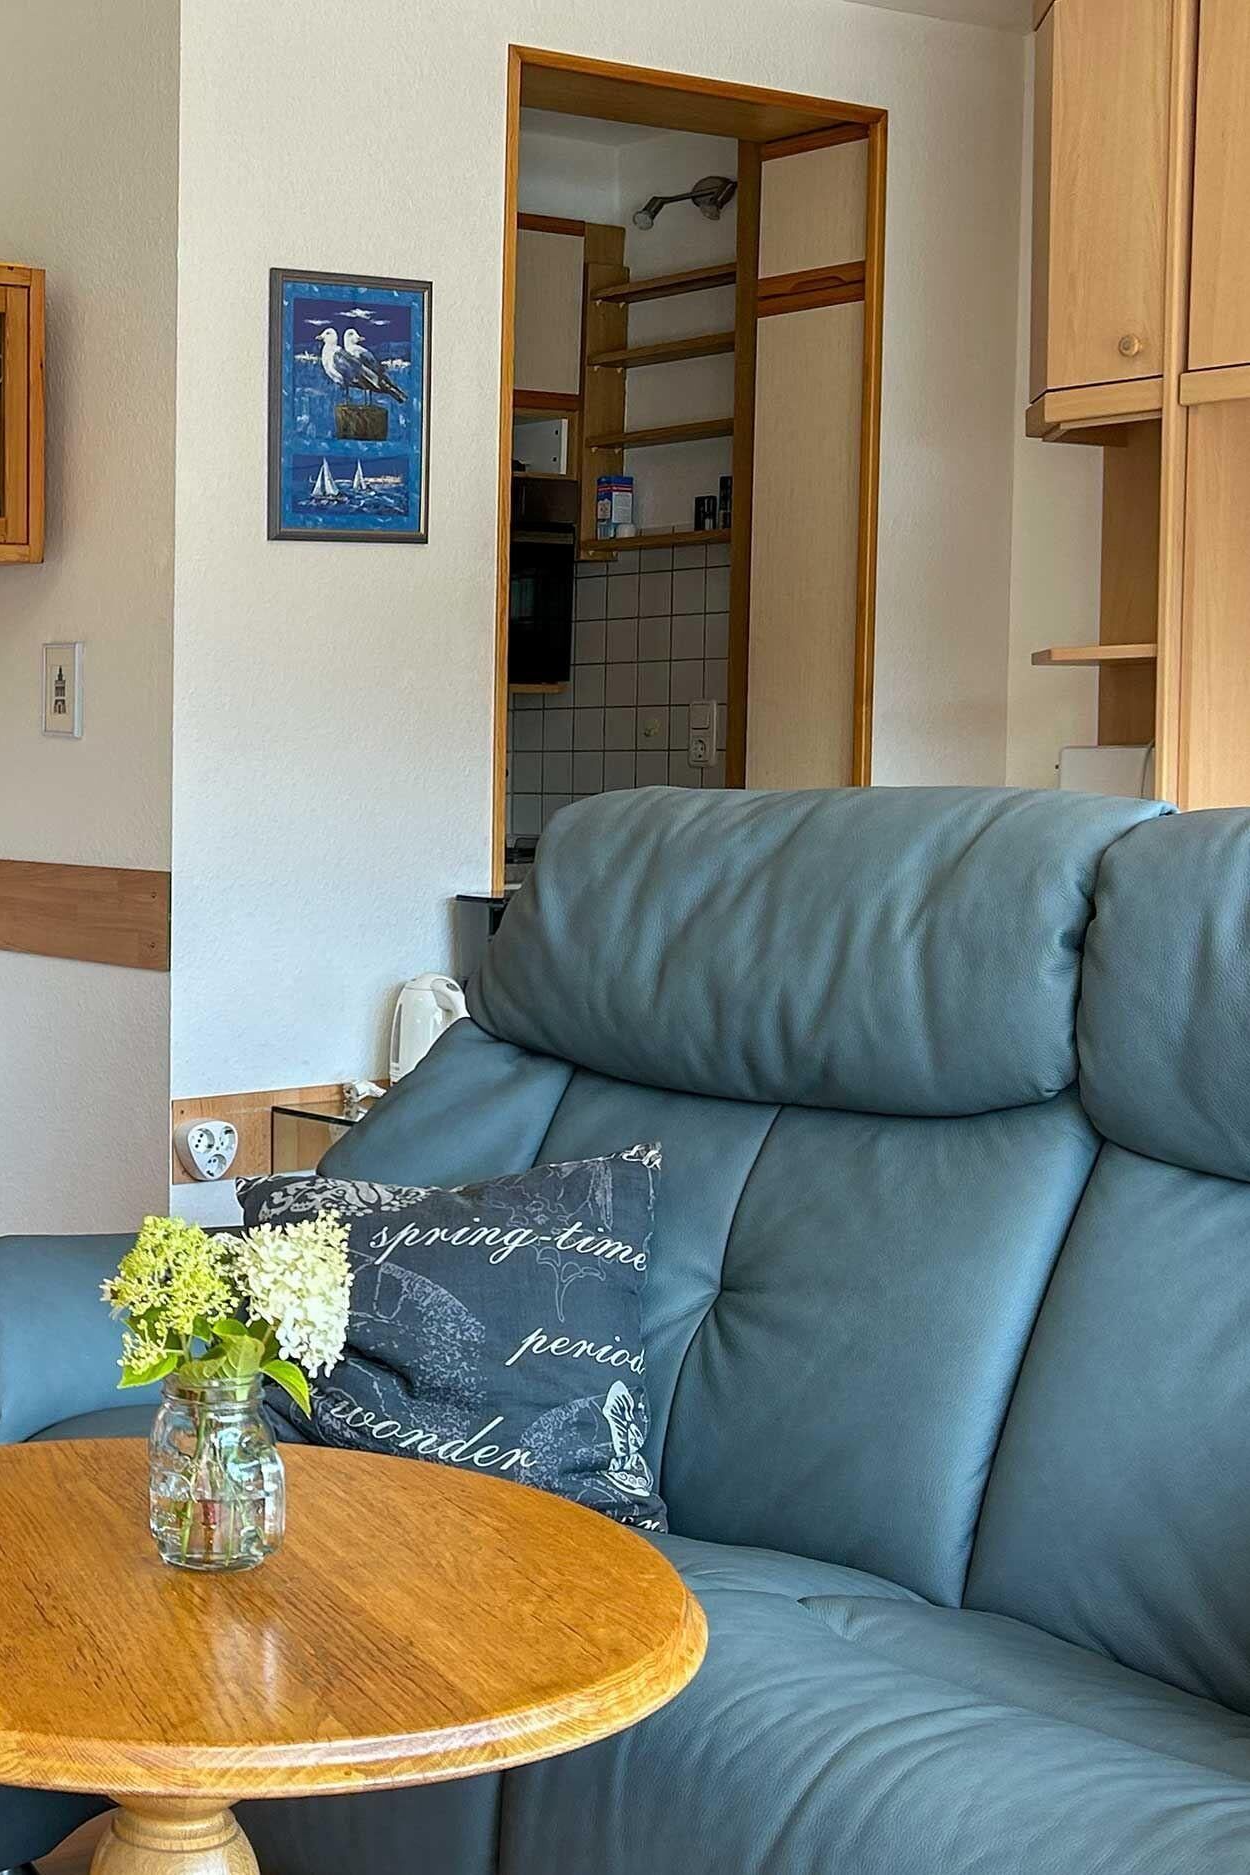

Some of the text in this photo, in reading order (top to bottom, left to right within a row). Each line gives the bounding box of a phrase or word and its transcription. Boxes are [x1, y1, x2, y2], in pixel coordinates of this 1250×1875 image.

[369, 1217, 647, 1271] spring-time
[505, 1327, 646, 1375] period
[330, 1399, 538, 1470] wonder
